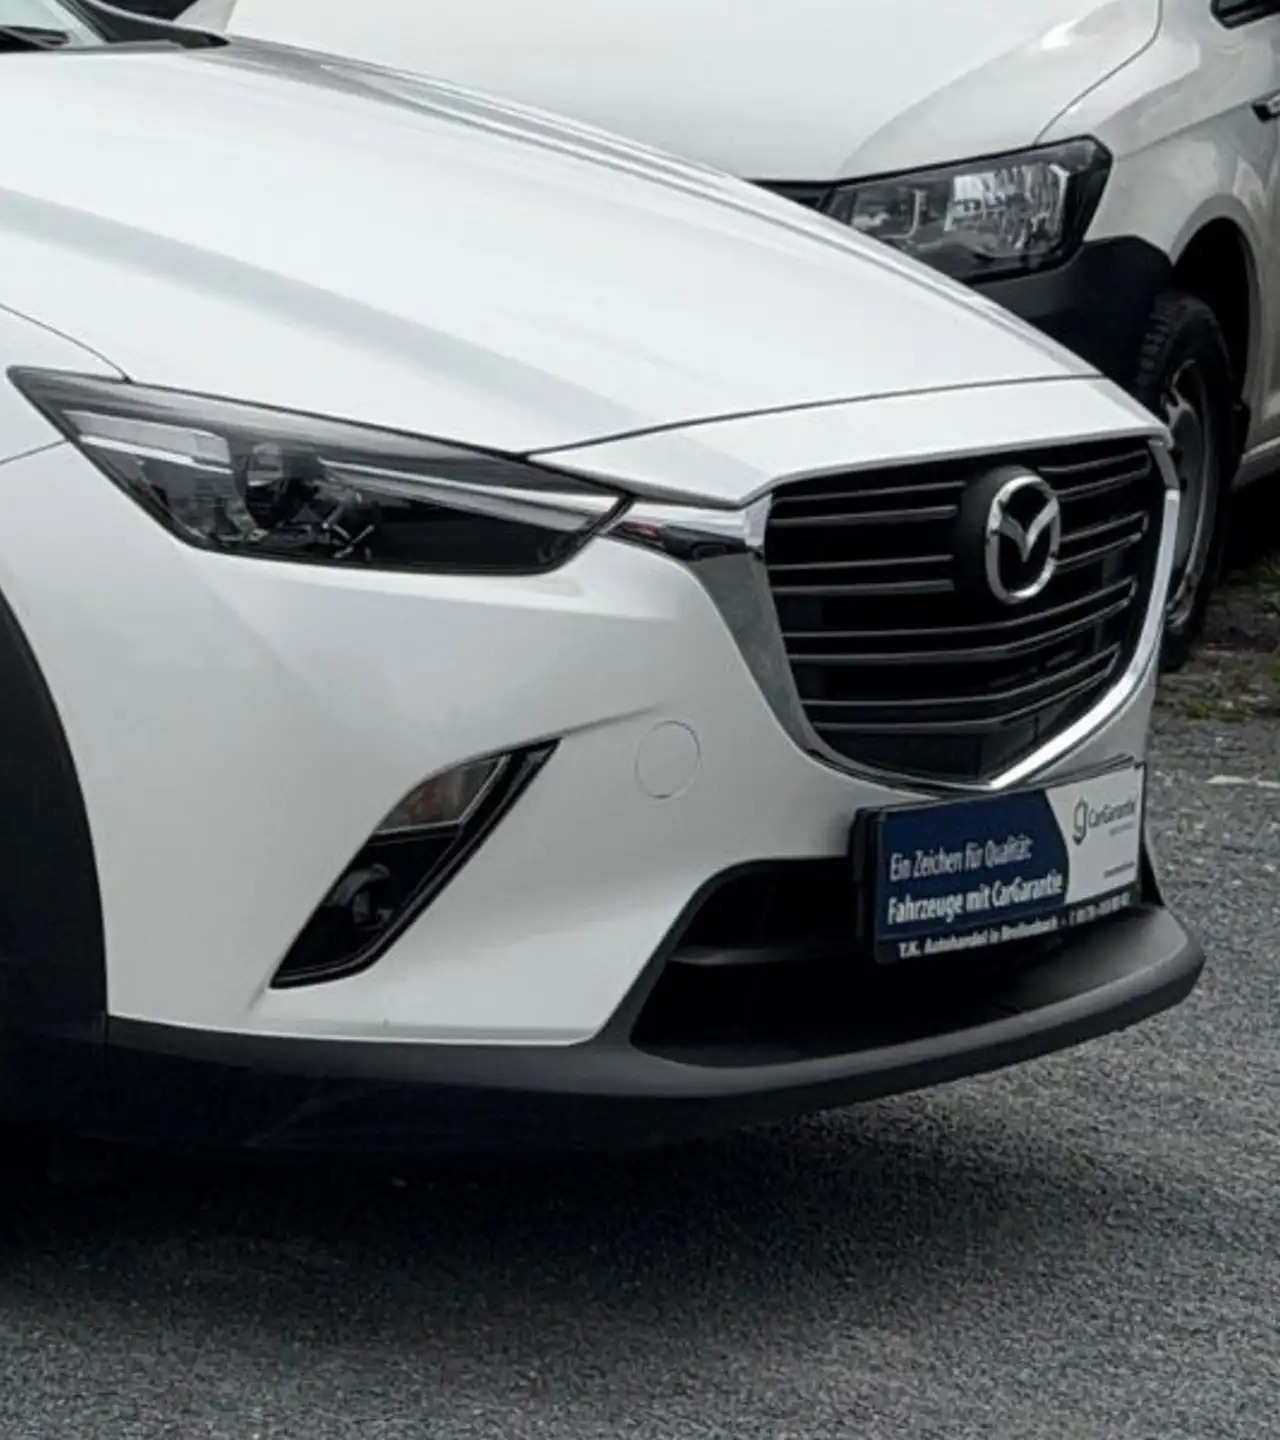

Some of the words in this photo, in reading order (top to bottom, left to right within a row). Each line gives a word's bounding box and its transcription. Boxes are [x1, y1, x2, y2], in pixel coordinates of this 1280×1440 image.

[889, 854, 912, 882] Ein
[913, 846, 962, 878] Zeichen
[965, 841, 984, 870] für
[887, 892, 964, 925] Fahrzeuge
[966, 886, 990, 912] mit
[992, 869, 1063, 908] CarGarantie
